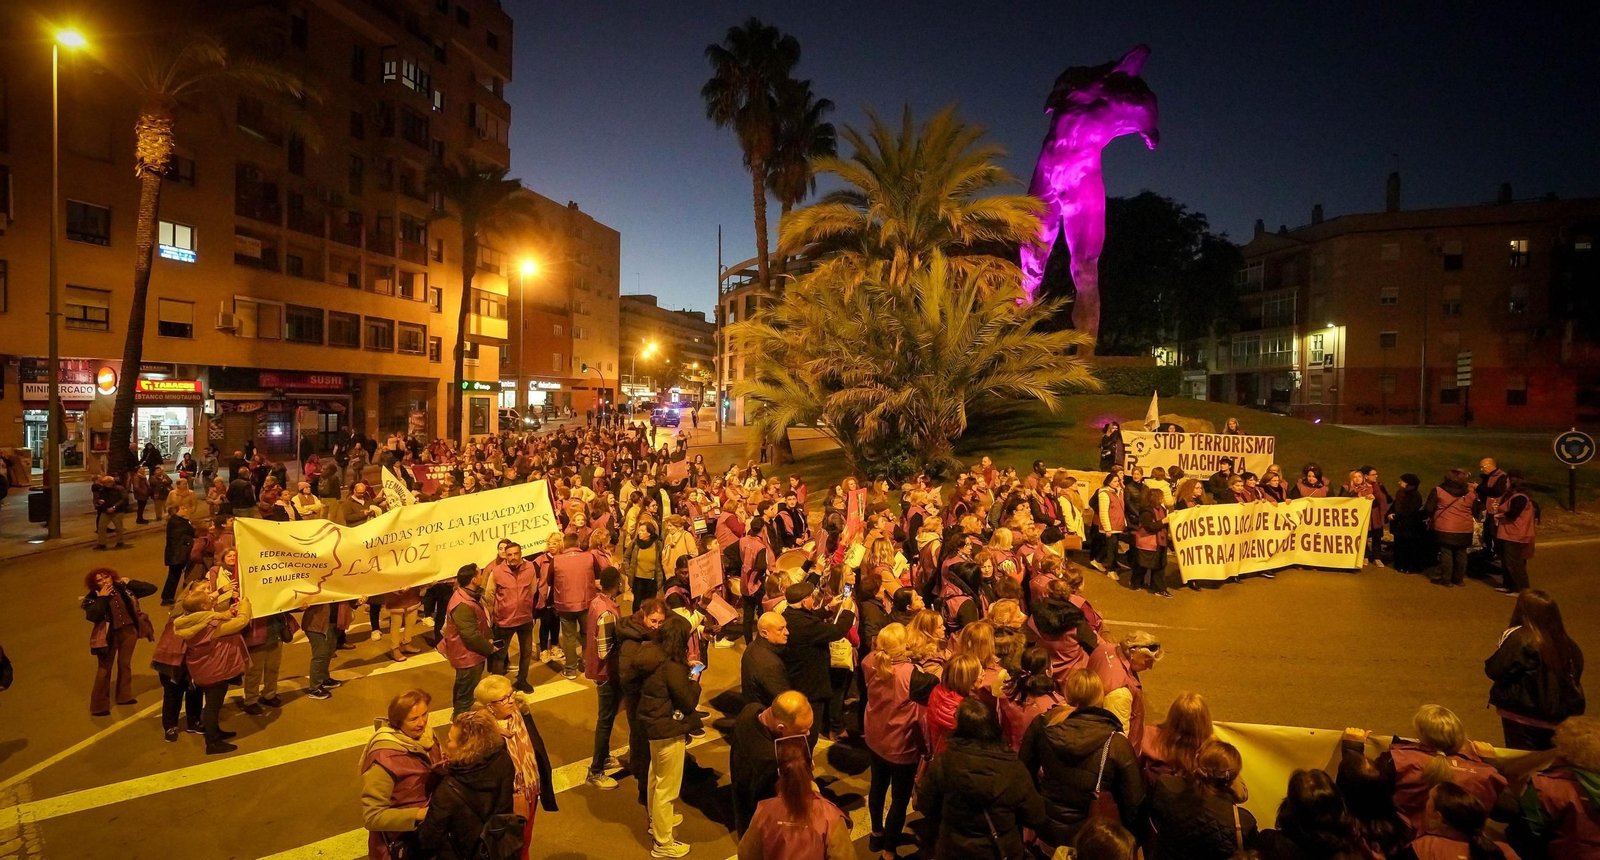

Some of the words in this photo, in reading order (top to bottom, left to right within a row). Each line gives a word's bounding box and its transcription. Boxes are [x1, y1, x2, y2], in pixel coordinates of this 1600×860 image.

[25, 385, 93, 394] MINIRCADO
[310, 375, 342, 385] SUSHI
[1153, 433, 1186, 450] STOP
[1189, 433, 1274, 455] TERRORISMO
[1178, 453, 1246, 474] MACHITA
[363, 528, 413, 549] UNIDAS
[416, 522, 444, 537] POR
[447, 517, 465, 530] LA
[468, 501, 535, 526] IGUALDAD
[1175, 515, 1231, 543] CONSEJO
[1255, 512, 1269, 531] DE
[260, 550, 317, 559] FEDERACIÓN
[343, 555, 382, 577] LA
[387, 543, 431, 567] VOZ
[435, 543, 447, 552] DE
[449, 539, 465, 548] LAS
[469, 513, 550, 546] MUJERES
[1180, 544, 1225, 567] ONTRA
[248, 566, 259, 574] DE
[260, 561, 328, 572] ASOCIACIONES
[262, 576, 273, 585] DE
[274, 572, 310, 583] MUJERES
